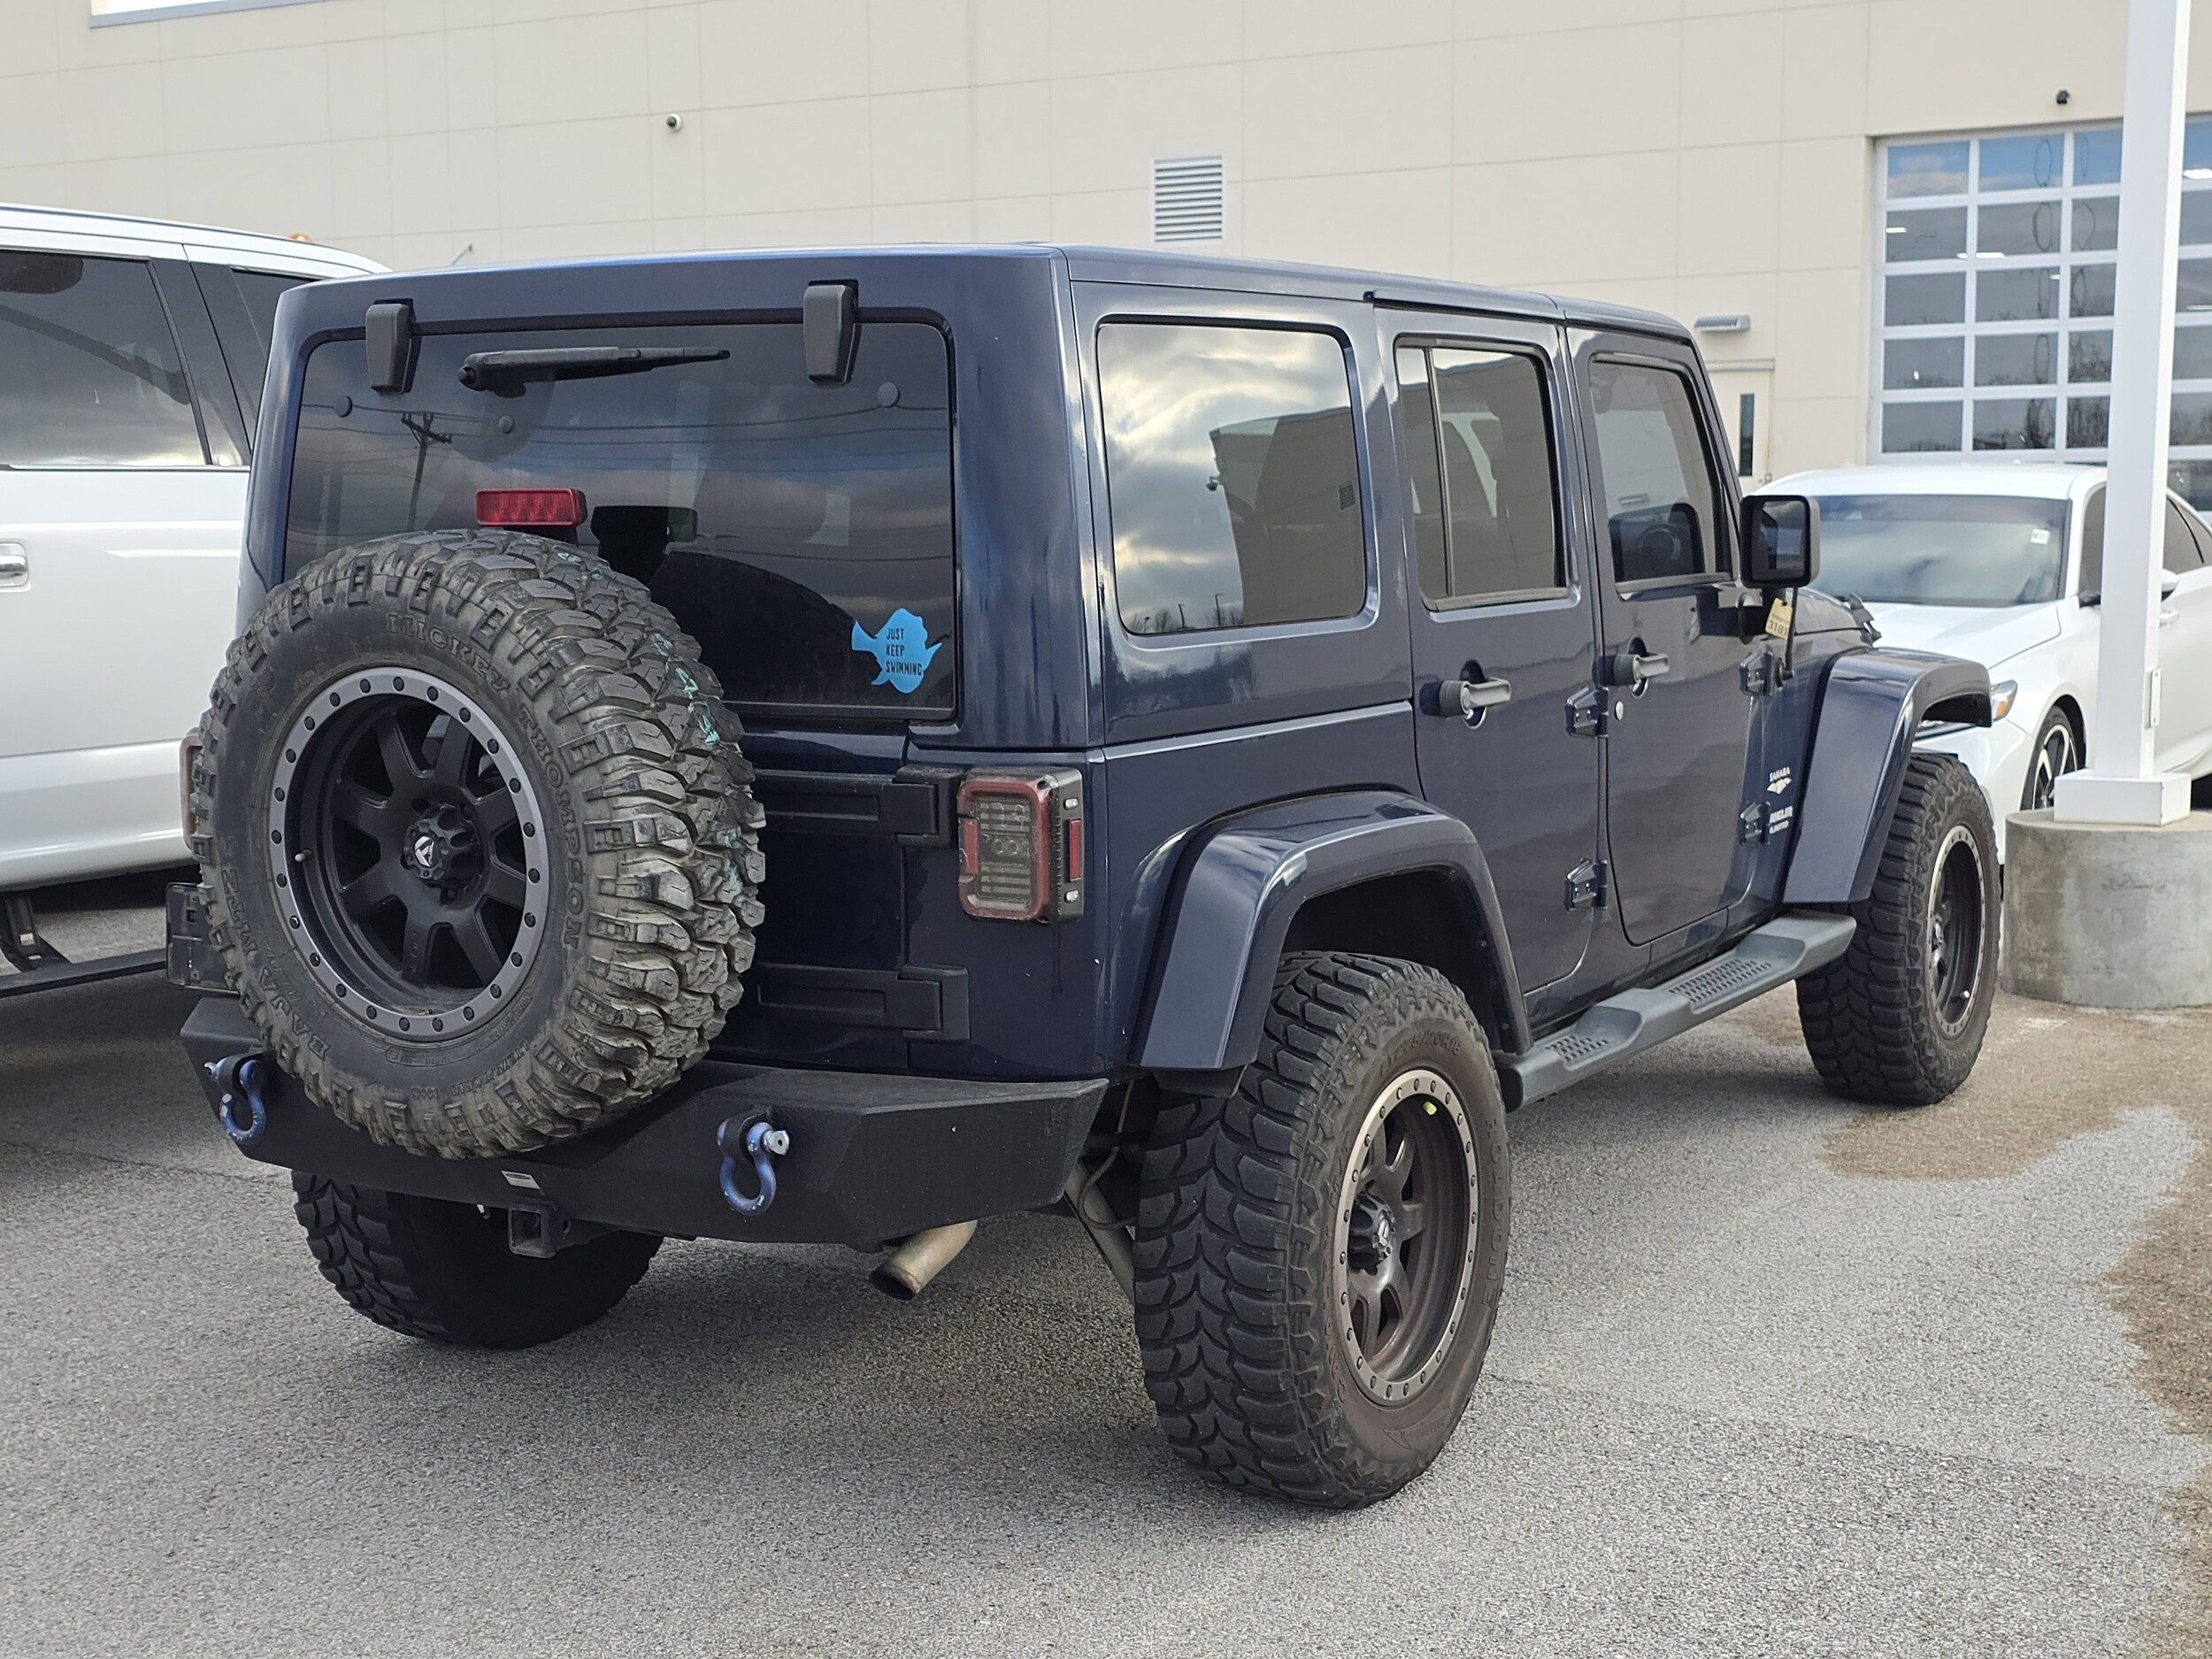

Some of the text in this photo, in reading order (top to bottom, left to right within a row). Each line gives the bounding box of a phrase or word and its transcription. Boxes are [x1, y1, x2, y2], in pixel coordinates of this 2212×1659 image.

[886, 627, 904, 640] JUST
[1768, 620, 1788, 636] 3181
[886, 644, 904, 657] KEEP
[886, 661, 922, 676] SWIMMING
[386, 612, 583, 949] MICKEY THOMPSON
[1769, 766, 1791, 782] SAHARA
[221, 868, 331, 1061] BAJA MTZ
